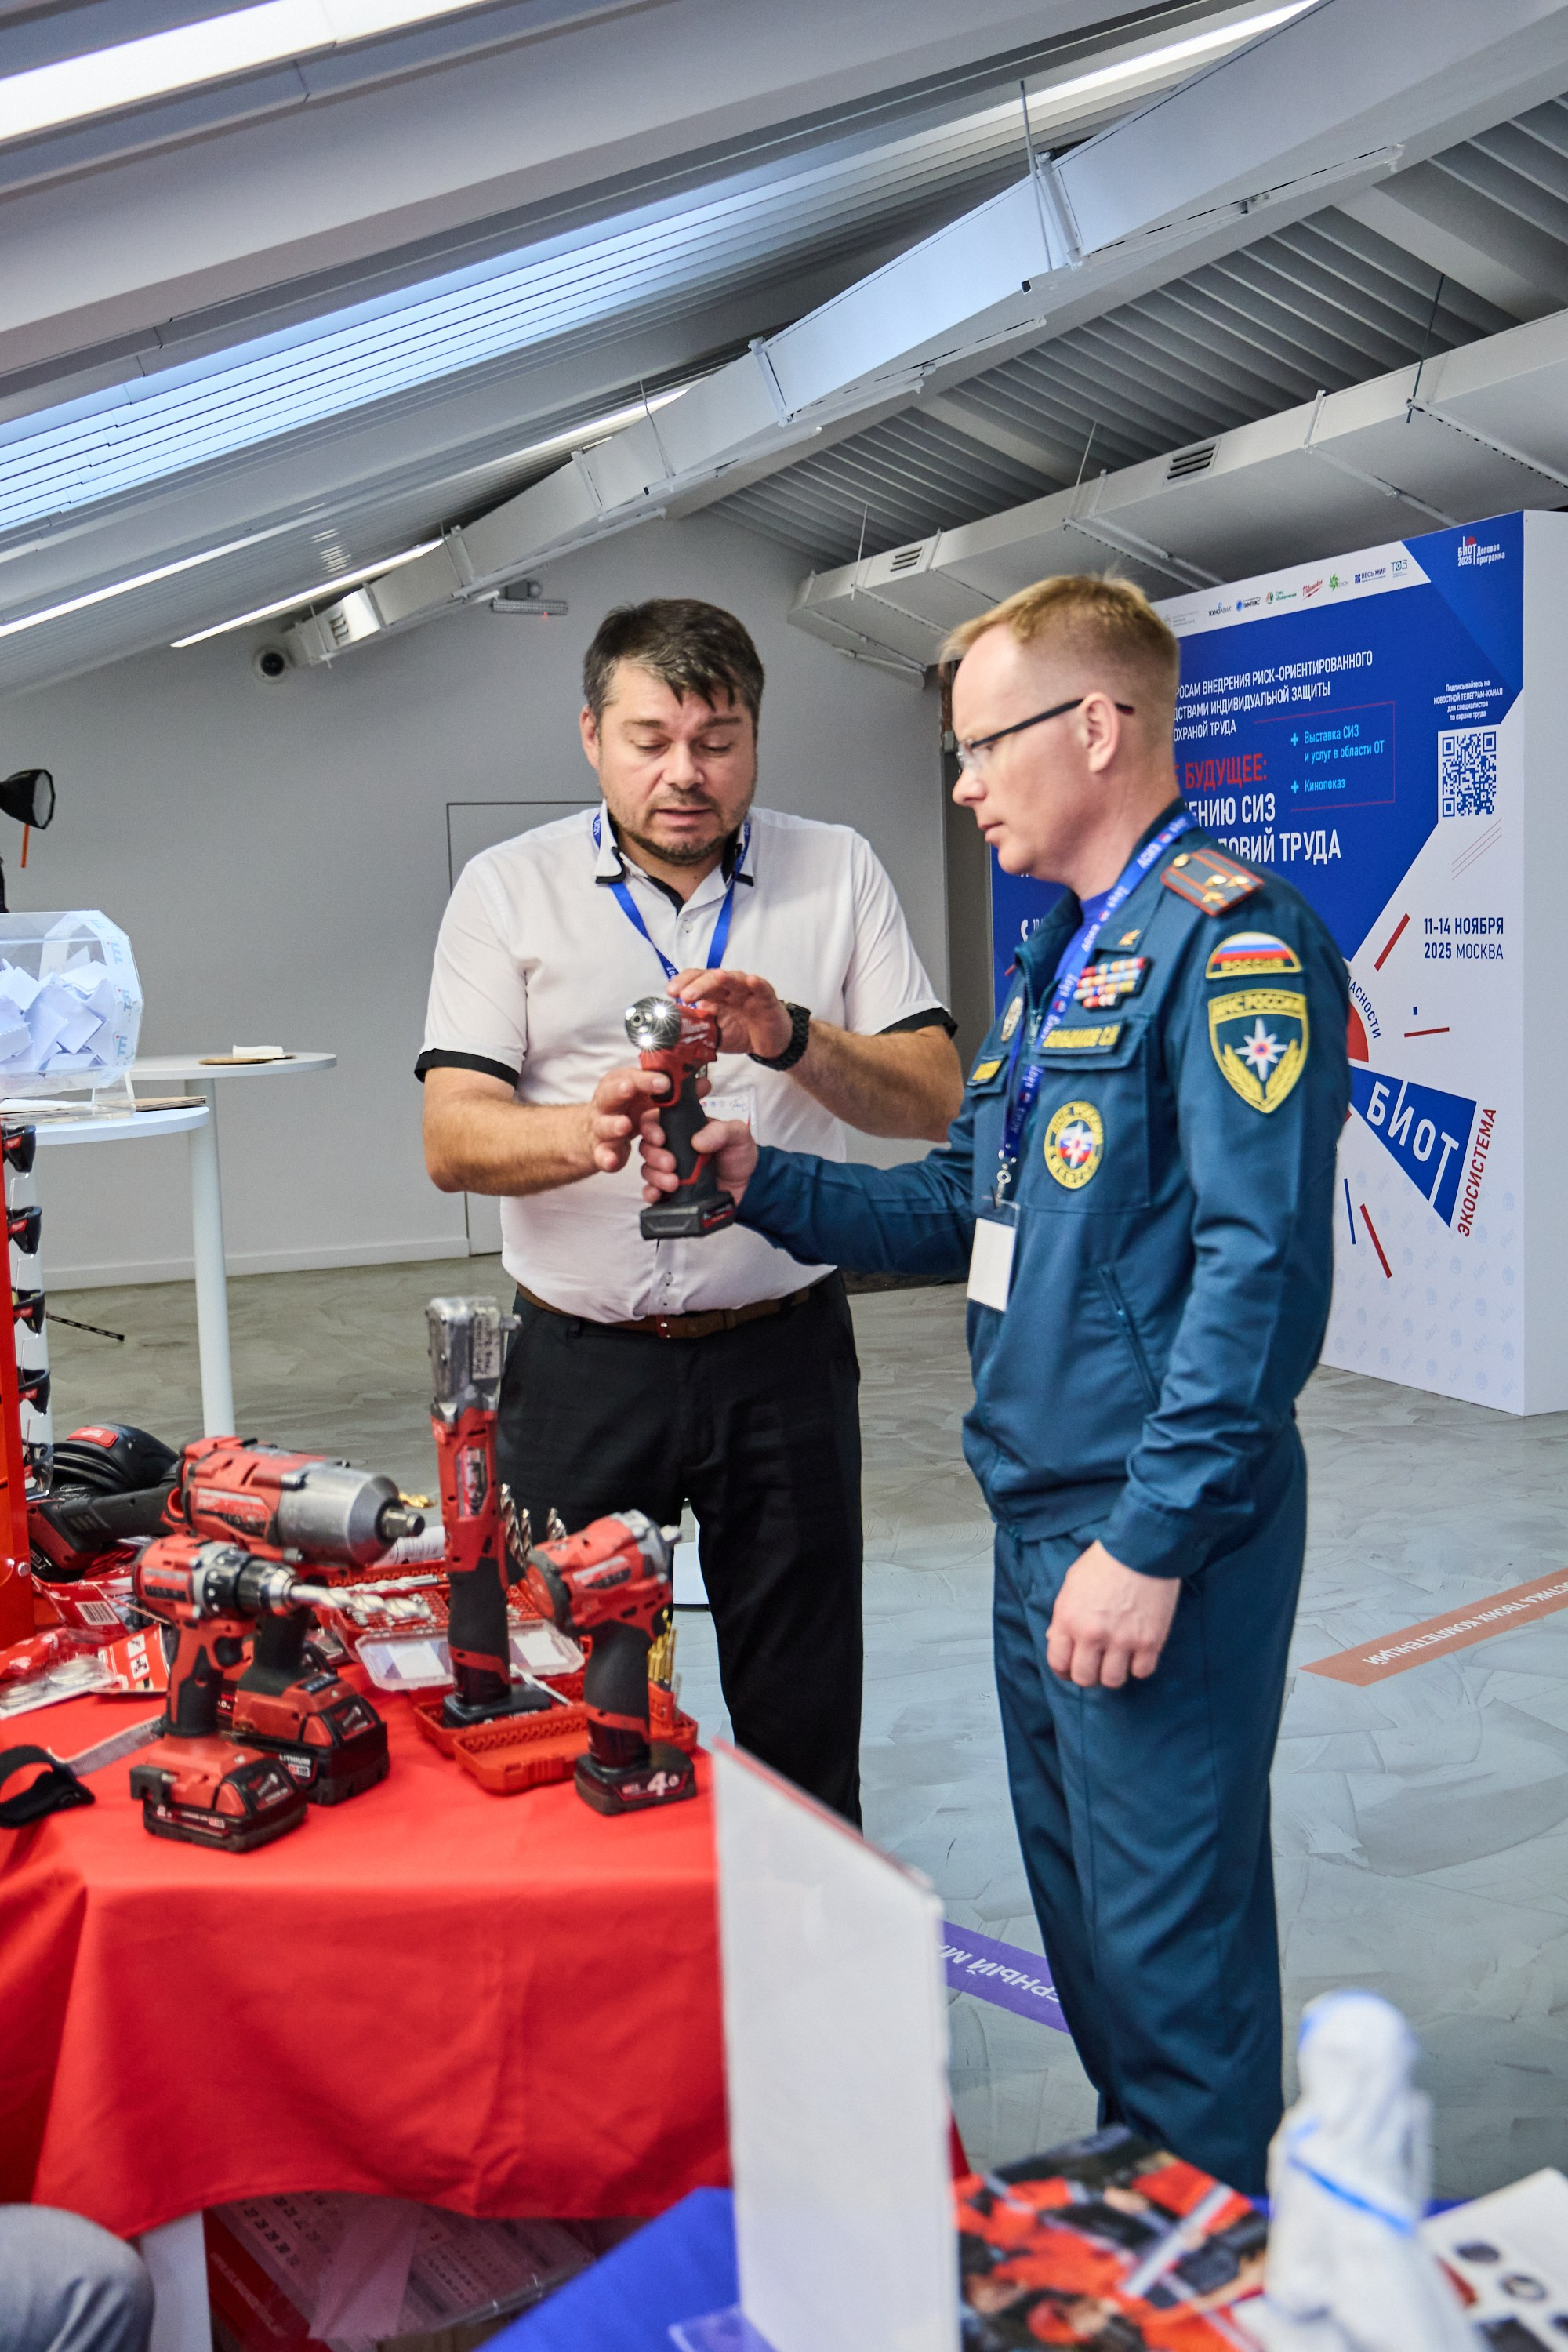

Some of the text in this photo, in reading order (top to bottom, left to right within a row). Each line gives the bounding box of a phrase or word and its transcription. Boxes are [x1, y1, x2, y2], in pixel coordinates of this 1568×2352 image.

[1458, 536, 1476, 565] БИОТ
[1458, 555, 1472, 567] 2025
[1477, 544, 1500, 557] Деловая
[1477, 552, 1505, 566] программа
[1361, 571, 1374, 579] ВЕСЬ
[1374, 568, 1386, 576] МИР
[1175, 650, 1373, 699] РОСАМ ВНЕДРЕНИЯ РИСК-ОРИЕНТИРОВАННОГО
[1434, 688, 1503, 705] НОВОСТНОЙ ТЕЛЕГРАМ-КАНАЛ
[1446, 681, 1483, 692] Подписывайтесь
[1174, 681, 1330, 722] ДСТВАМИ ИНДИВИДУАЛЬНОЙ ЗАЩИТЫ
[1447, 701, 1489, 713] для специалистов
[1456, 712, 1472, 721] охране
[1472, 710, 1486, 719] труда
[1174, 719, 1236, 742] ОХРАНОЙ ТРУДА
[1304, 724, 1359, 744] Выставка СИЗ
[1304, 753, 1309, 762] и
[1311, 750, 1331, 765] услуг
[1340, 743, 1372, 758] области
[1374, 740, 1385, 754] ОТ
[1185, 753, 1268, 792] БУДУЩЕЕ:
[1304, 779, 1345, 792] Кинопоказ
[1185, 797, 1236, 827] ЕНИЮ
[1241, 792, 1276, 824] СИЗ
[1218, 826, 1341, 865] ОВИЙ ТРУДА
[1424, 917, 1504, 935] 11-14 НОЯБРЯ
[1424, 942, 1504, 960] 2025 МОСКВА
[1367, 1080, 1459, 1207] БИОТ
[1457, 1109, 1497, 1237] ЭКОСИСТЕМА
[1475, 1602, 1530, 1623] ТВОИХ
[1362, 1619, 1483, 1665] КОМПЕТЕНЦИЙ
[966, 1958, 1060, 2003] РНЫЙ
